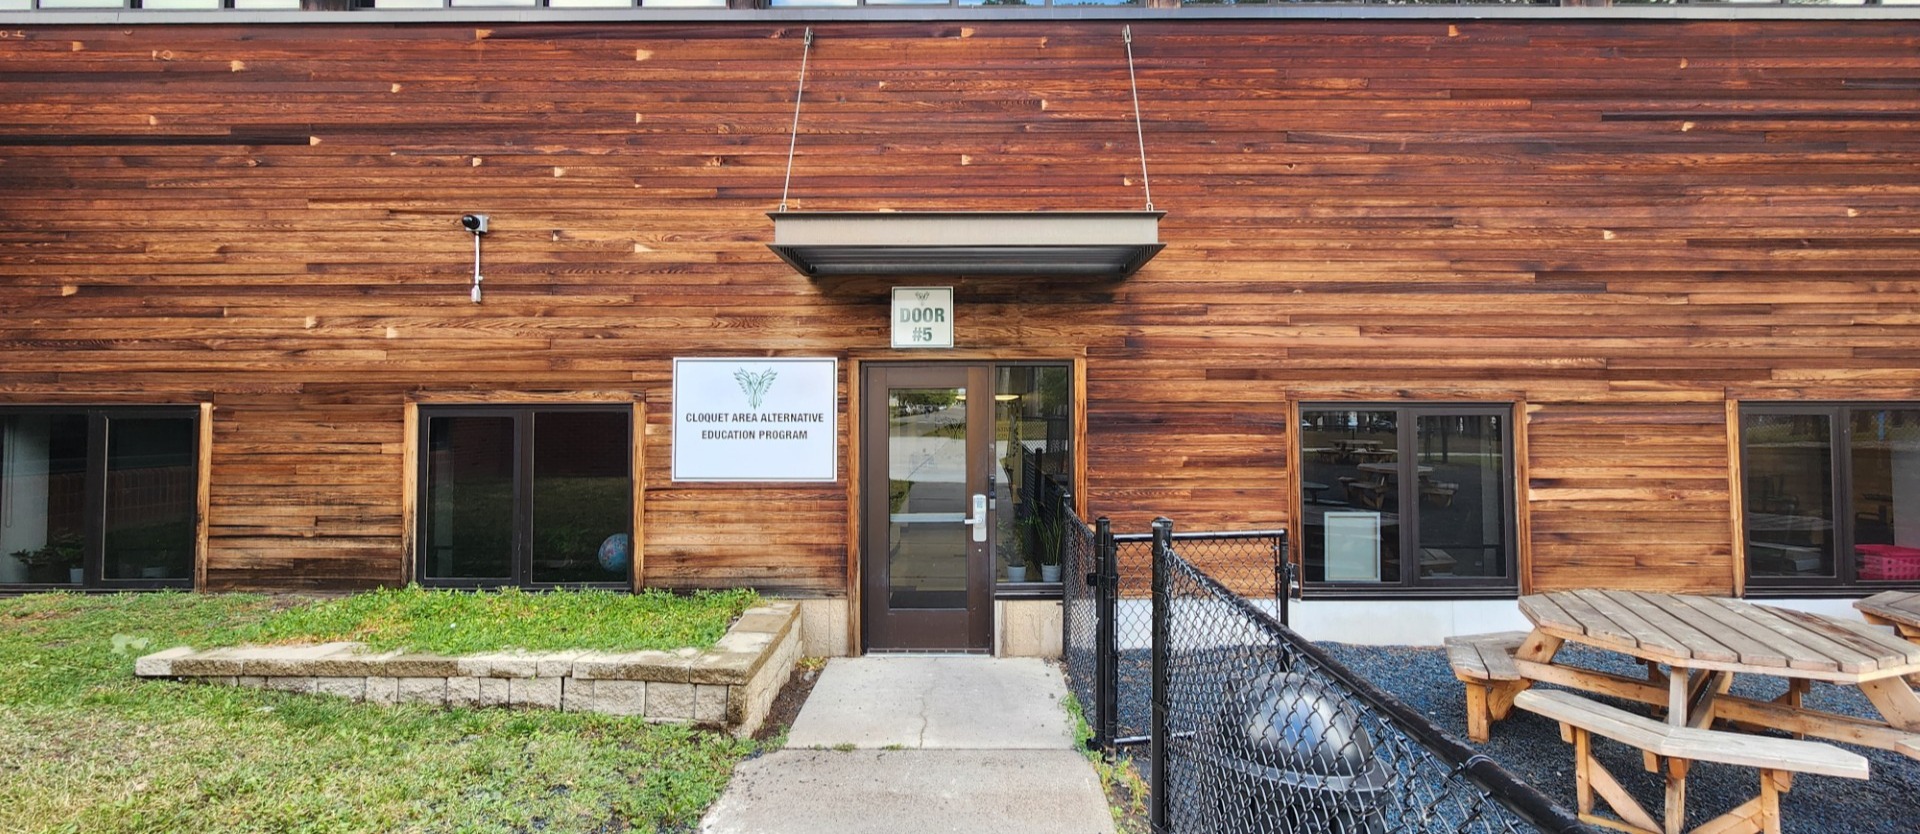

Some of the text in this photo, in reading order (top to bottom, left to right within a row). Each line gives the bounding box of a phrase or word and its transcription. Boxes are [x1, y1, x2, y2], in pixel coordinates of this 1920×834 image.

[900, 307, 945, 323] DOOR
[912, 327, 933, 342] #5
[686, 413, 824, 423] CLOQUET AREA ALTERNATIVE
[701, 430, 808, 440] EDUCATION PROGRAM
